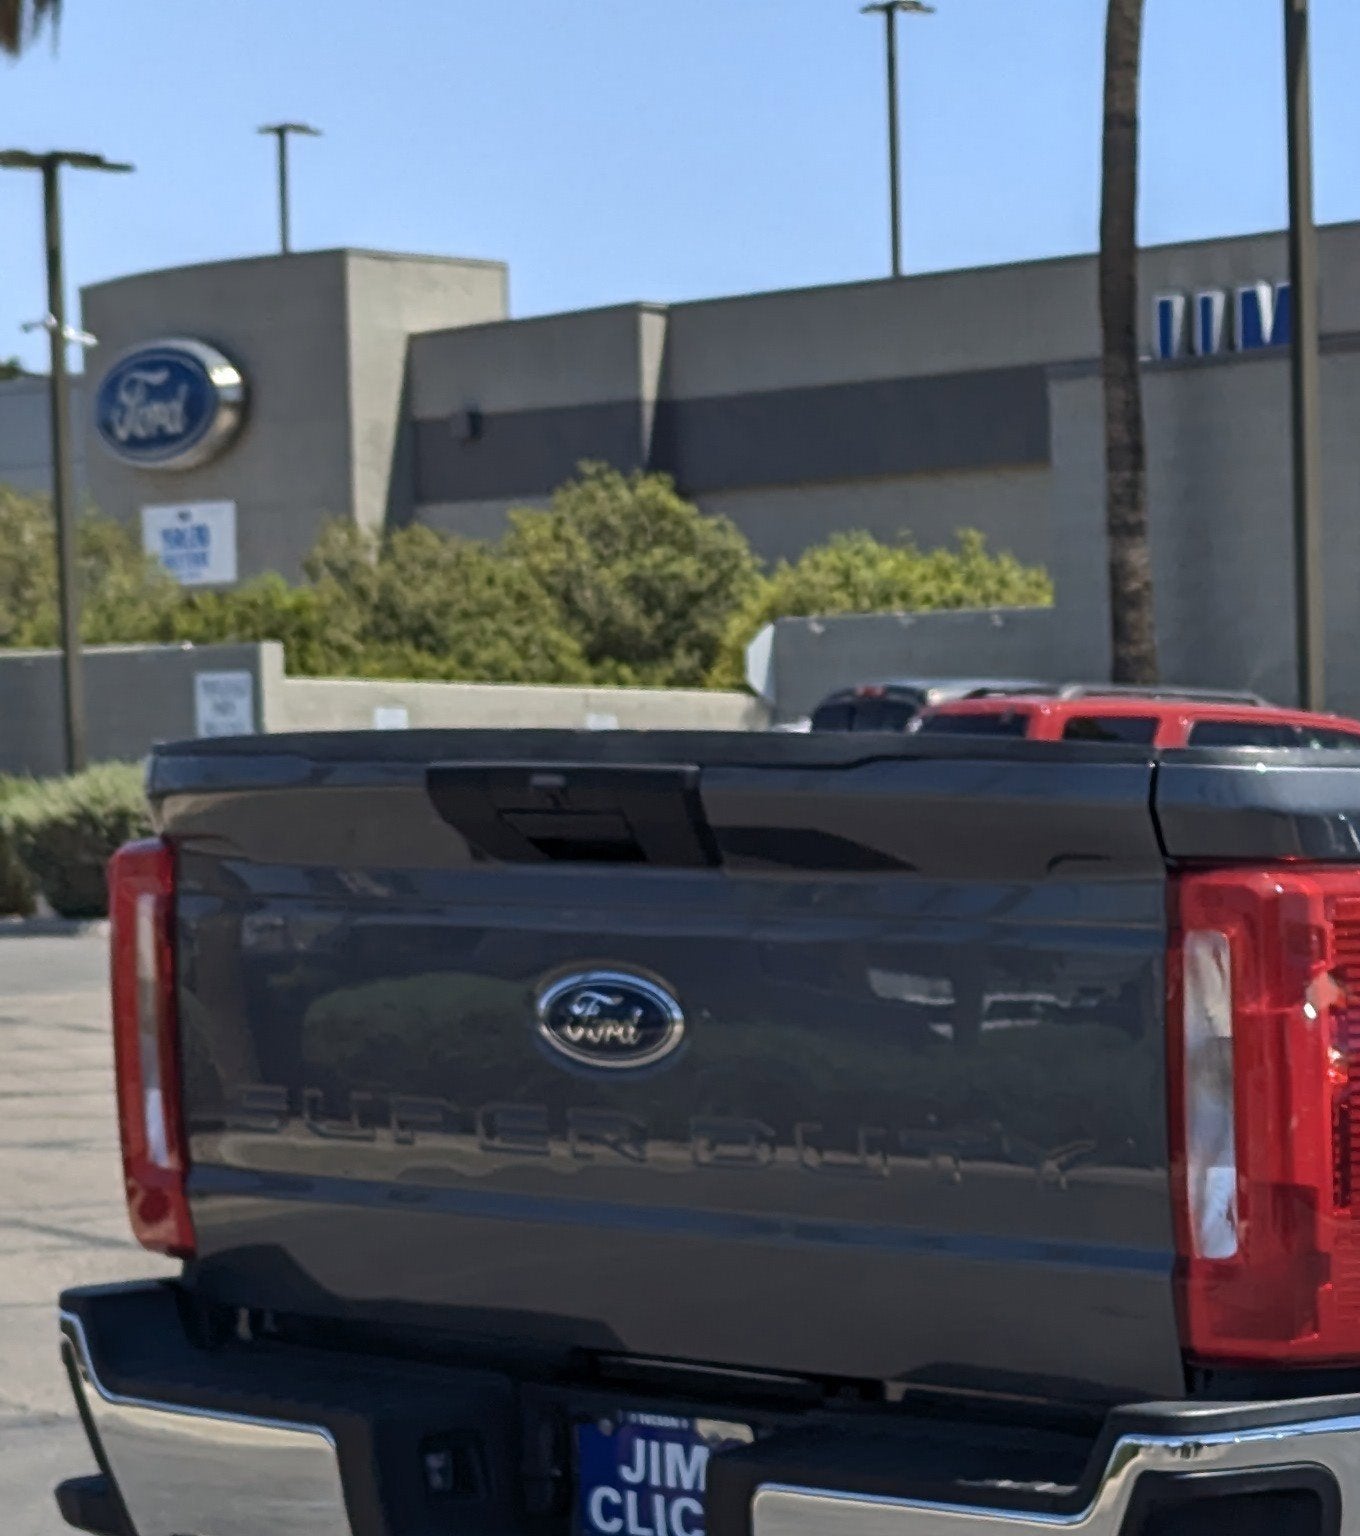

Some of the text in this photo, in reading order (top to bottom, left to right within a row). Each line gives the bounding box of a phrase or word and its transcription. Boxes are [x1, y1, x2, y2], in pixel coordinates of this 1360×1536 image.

[111, 366, 189, 441] Ford
[564, 990, 645, 1046] Ford
[620, 1438, 709, 1490] JIM
